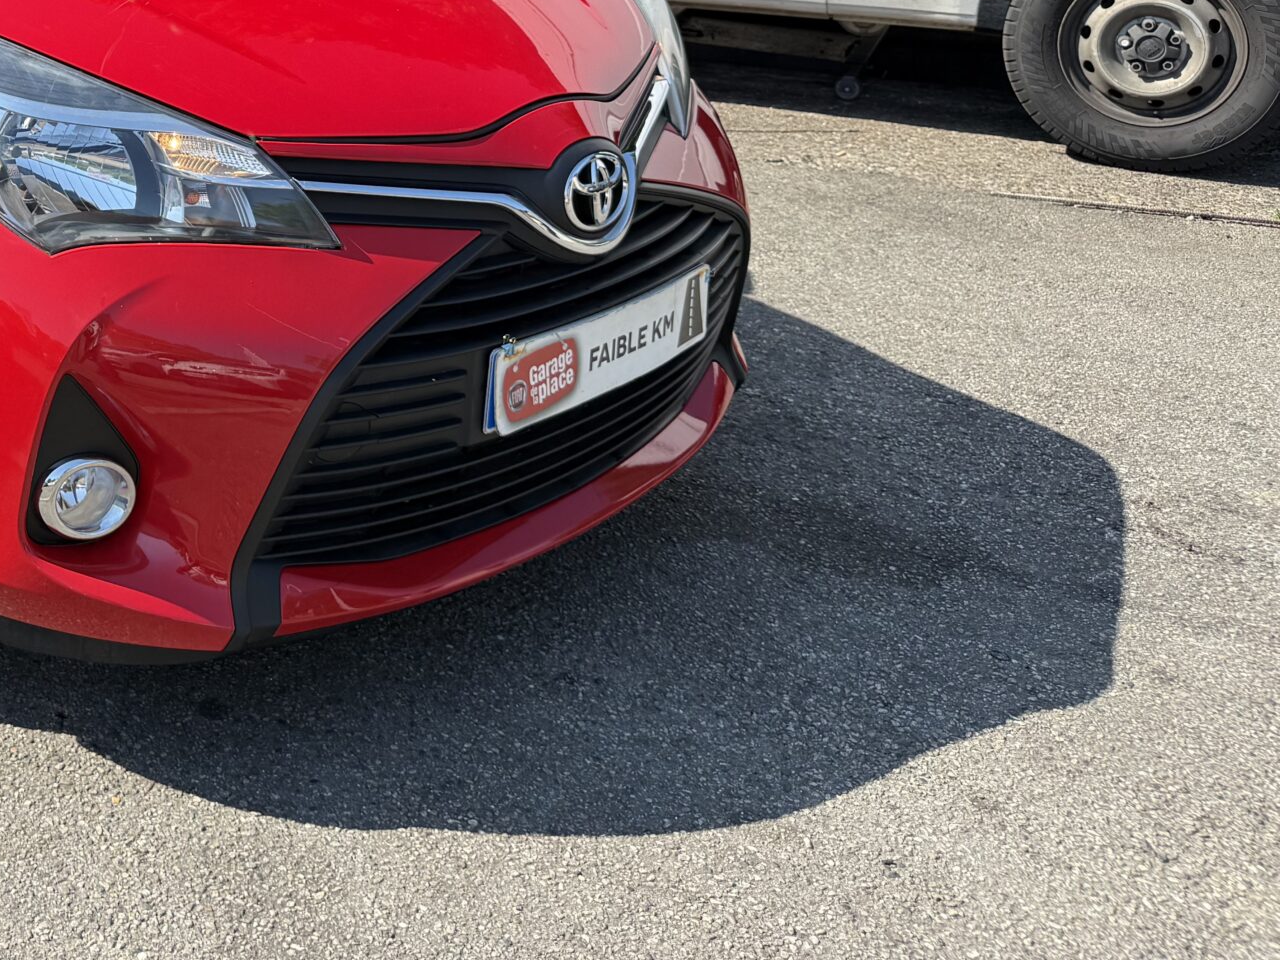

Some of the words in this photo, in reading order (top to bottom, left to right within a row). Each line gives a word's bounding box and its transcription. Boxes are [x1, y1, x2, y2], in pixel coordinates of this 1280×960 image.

[588, 324, 648, 372] FAIBLE
[651, 311, 674, 342] KM
[529, 348, 573, 385] Garage
[538, 368, 574, 404] place
